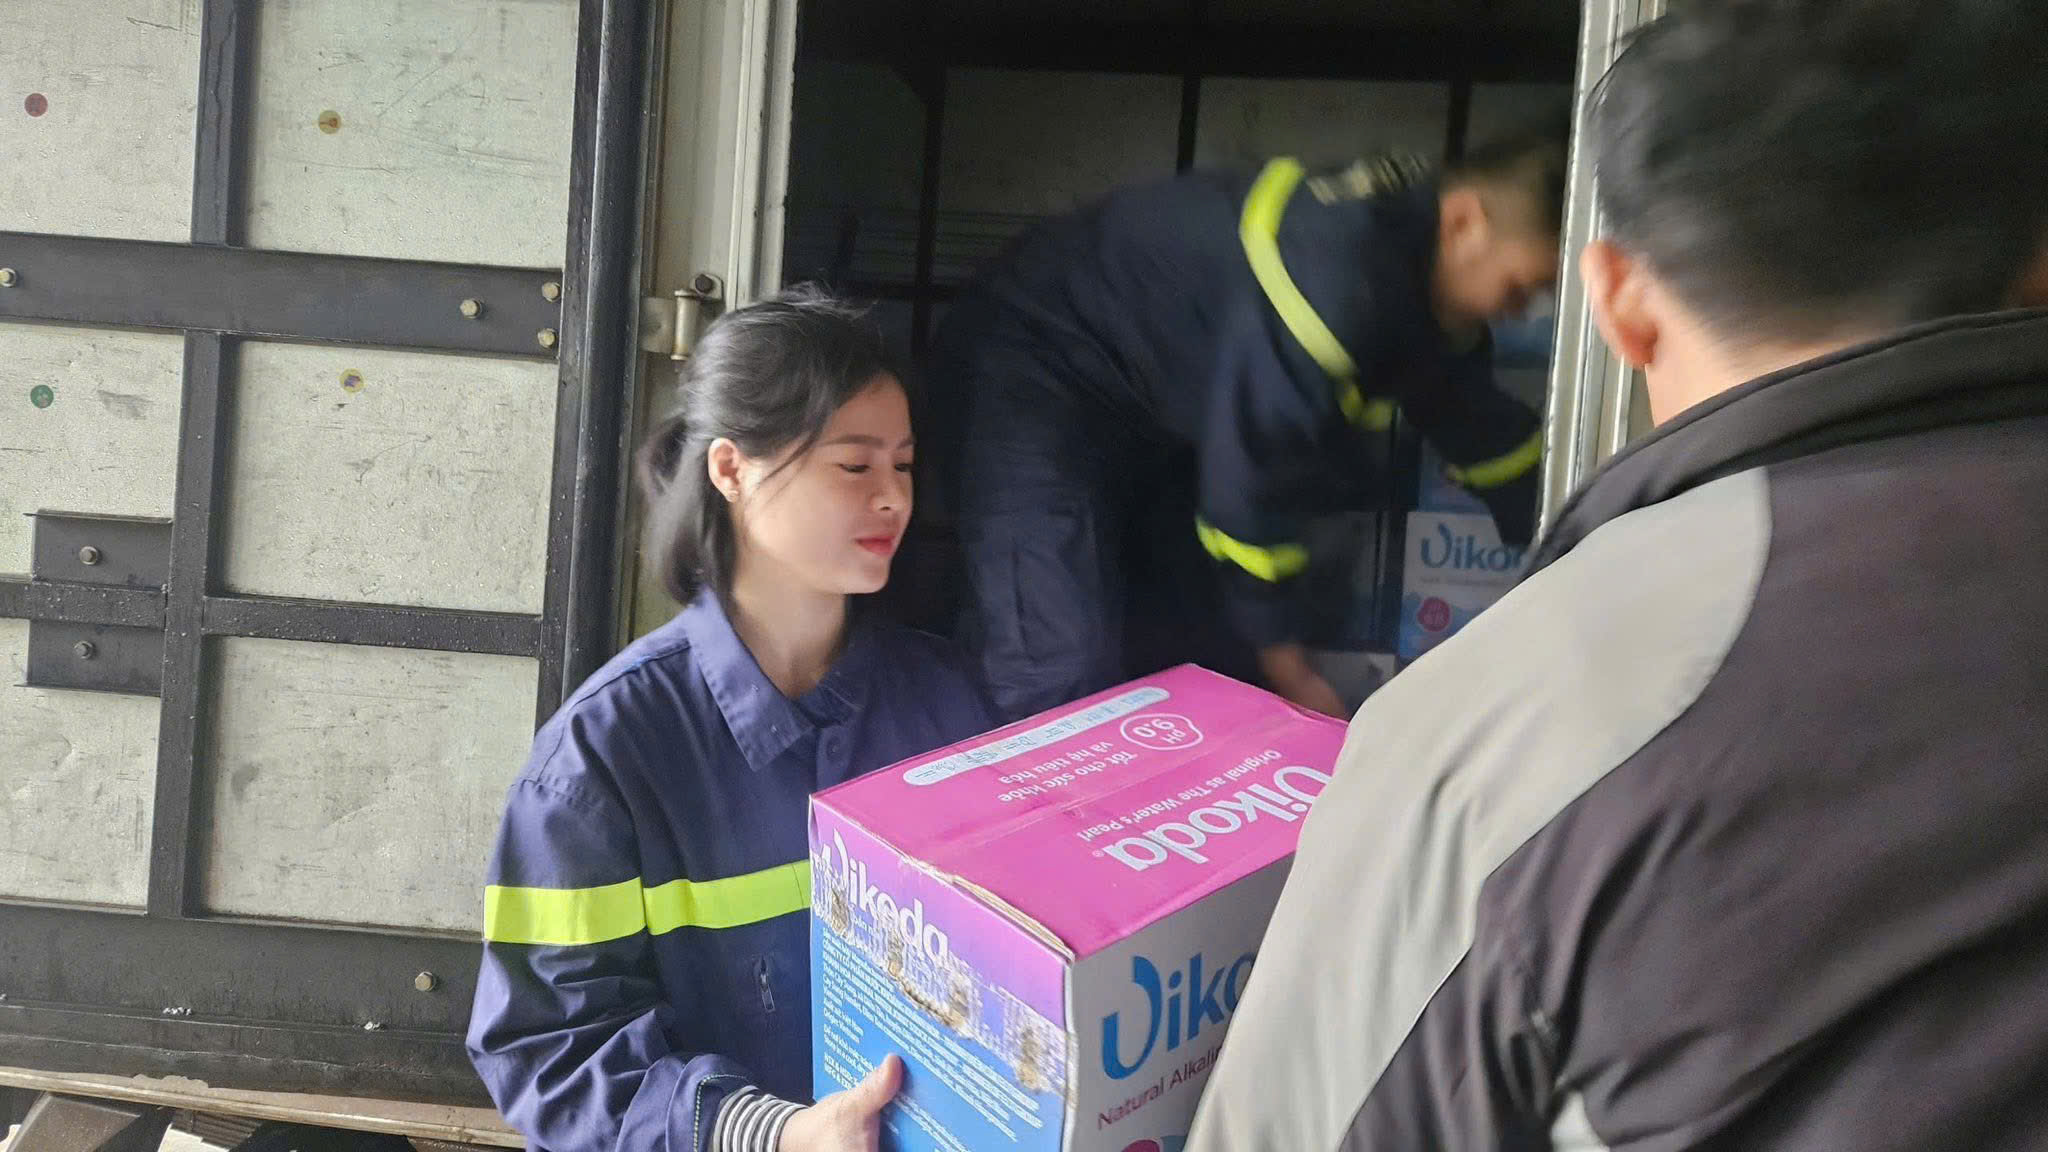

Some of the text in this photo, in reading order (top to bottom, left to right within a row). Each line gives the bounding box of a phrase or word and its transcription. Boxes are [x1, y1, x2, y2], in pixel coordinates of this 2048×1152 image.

[1132, 718, 1176, 740] 9.0
[1158, 728, 1186, 746] pH
[1069, 747, 1095, 765] hệ
[1090, 740, 1115, 756] và
[1032, 757, 1072, 776] tiêu
[1104, 750, 1138, 767] Tốt
[1074, 760, 1107, 778] cho
[1043, 772, 1076, 791] sức
[1075, 749, 1284, 842] Original as The Water's Pearl
[1097, 1077, 1164, 1130] Natural
